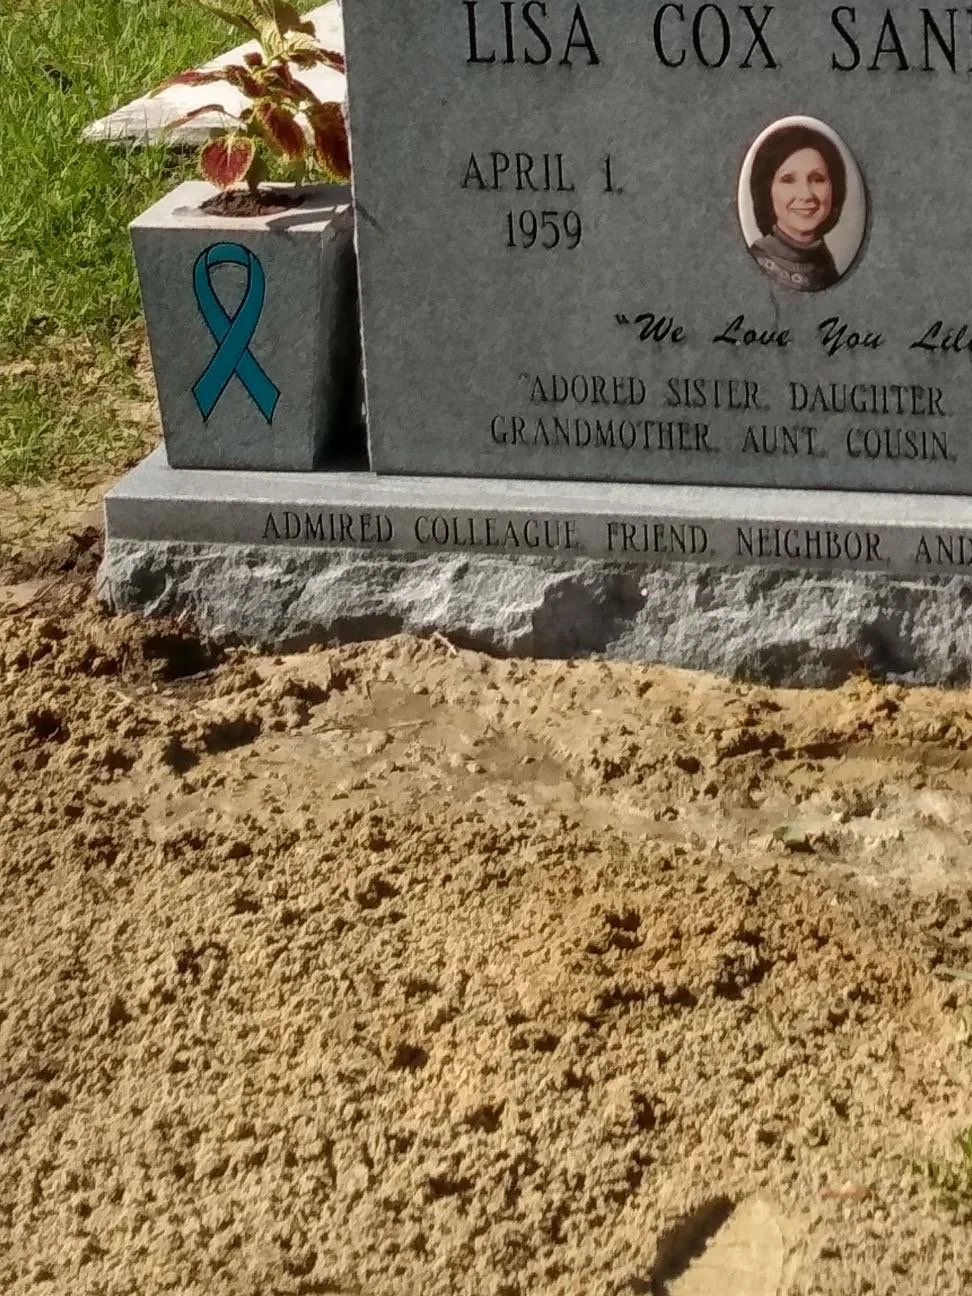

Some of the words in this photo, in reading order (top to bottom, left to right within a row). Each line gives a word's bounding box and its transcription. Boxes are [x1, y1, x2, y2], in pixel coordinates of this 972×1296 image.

[461, 0, 602, 69] LISA
[652, 2, 782, 71] COX
[460, 150, 576, 192] APRIL
[506, 208, 582, 250] 1959
[712, 313, 792, 348] Love
[817, 315, 883, 357] You
[261, 511, 394, 544] ADMIRED
